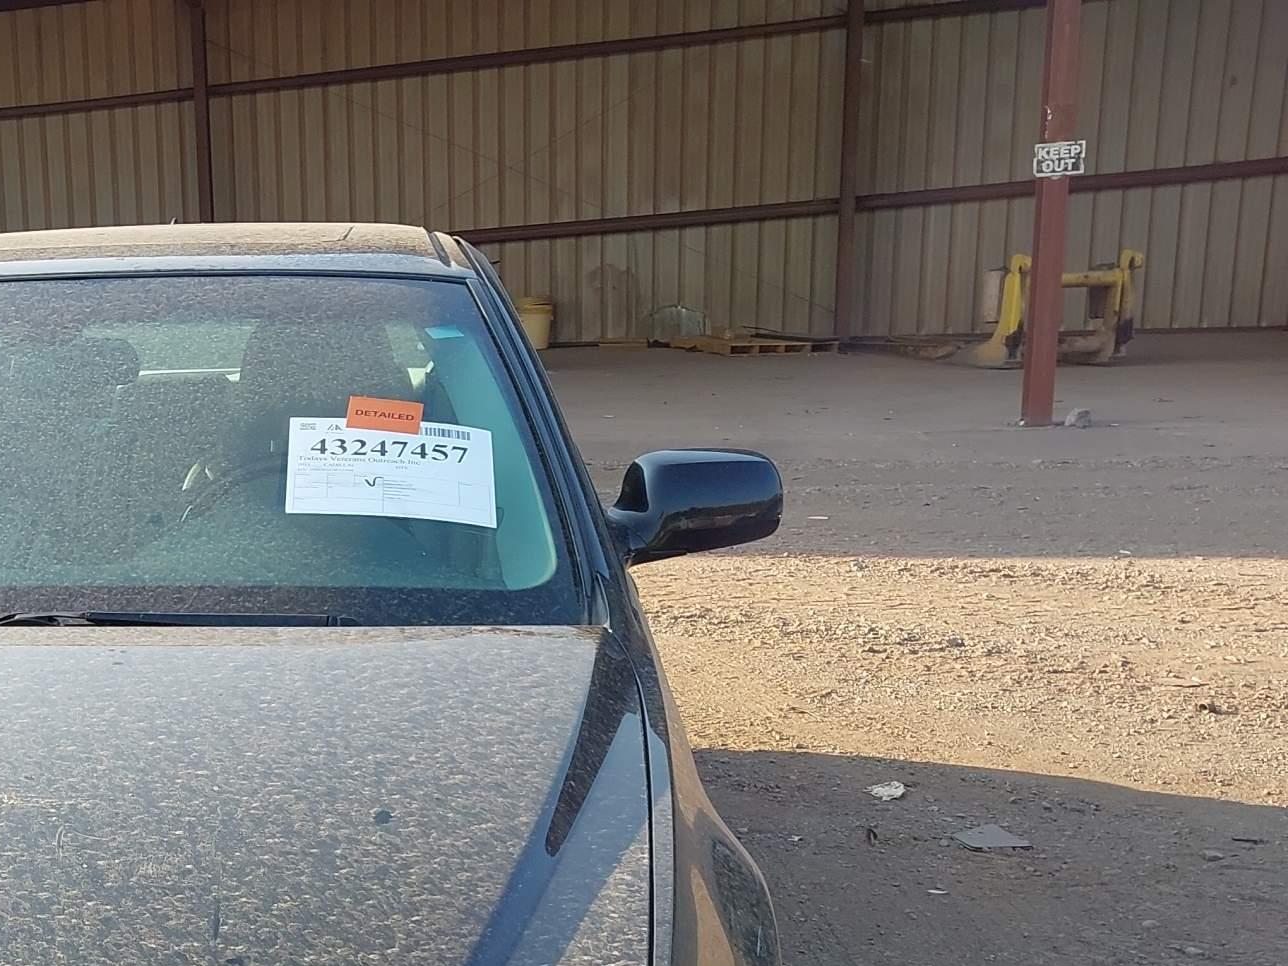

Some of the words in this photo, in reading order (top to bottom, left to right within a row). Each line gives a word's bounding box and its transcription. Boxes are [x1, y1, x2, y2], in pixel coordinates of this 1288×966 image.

[1038, 145, 1081, 160] KEEP
[1042, 159, 1076, 172] OUT
[355, 409, 414, 421] DETAILED
[310, 438, 468, 463] 43247457
